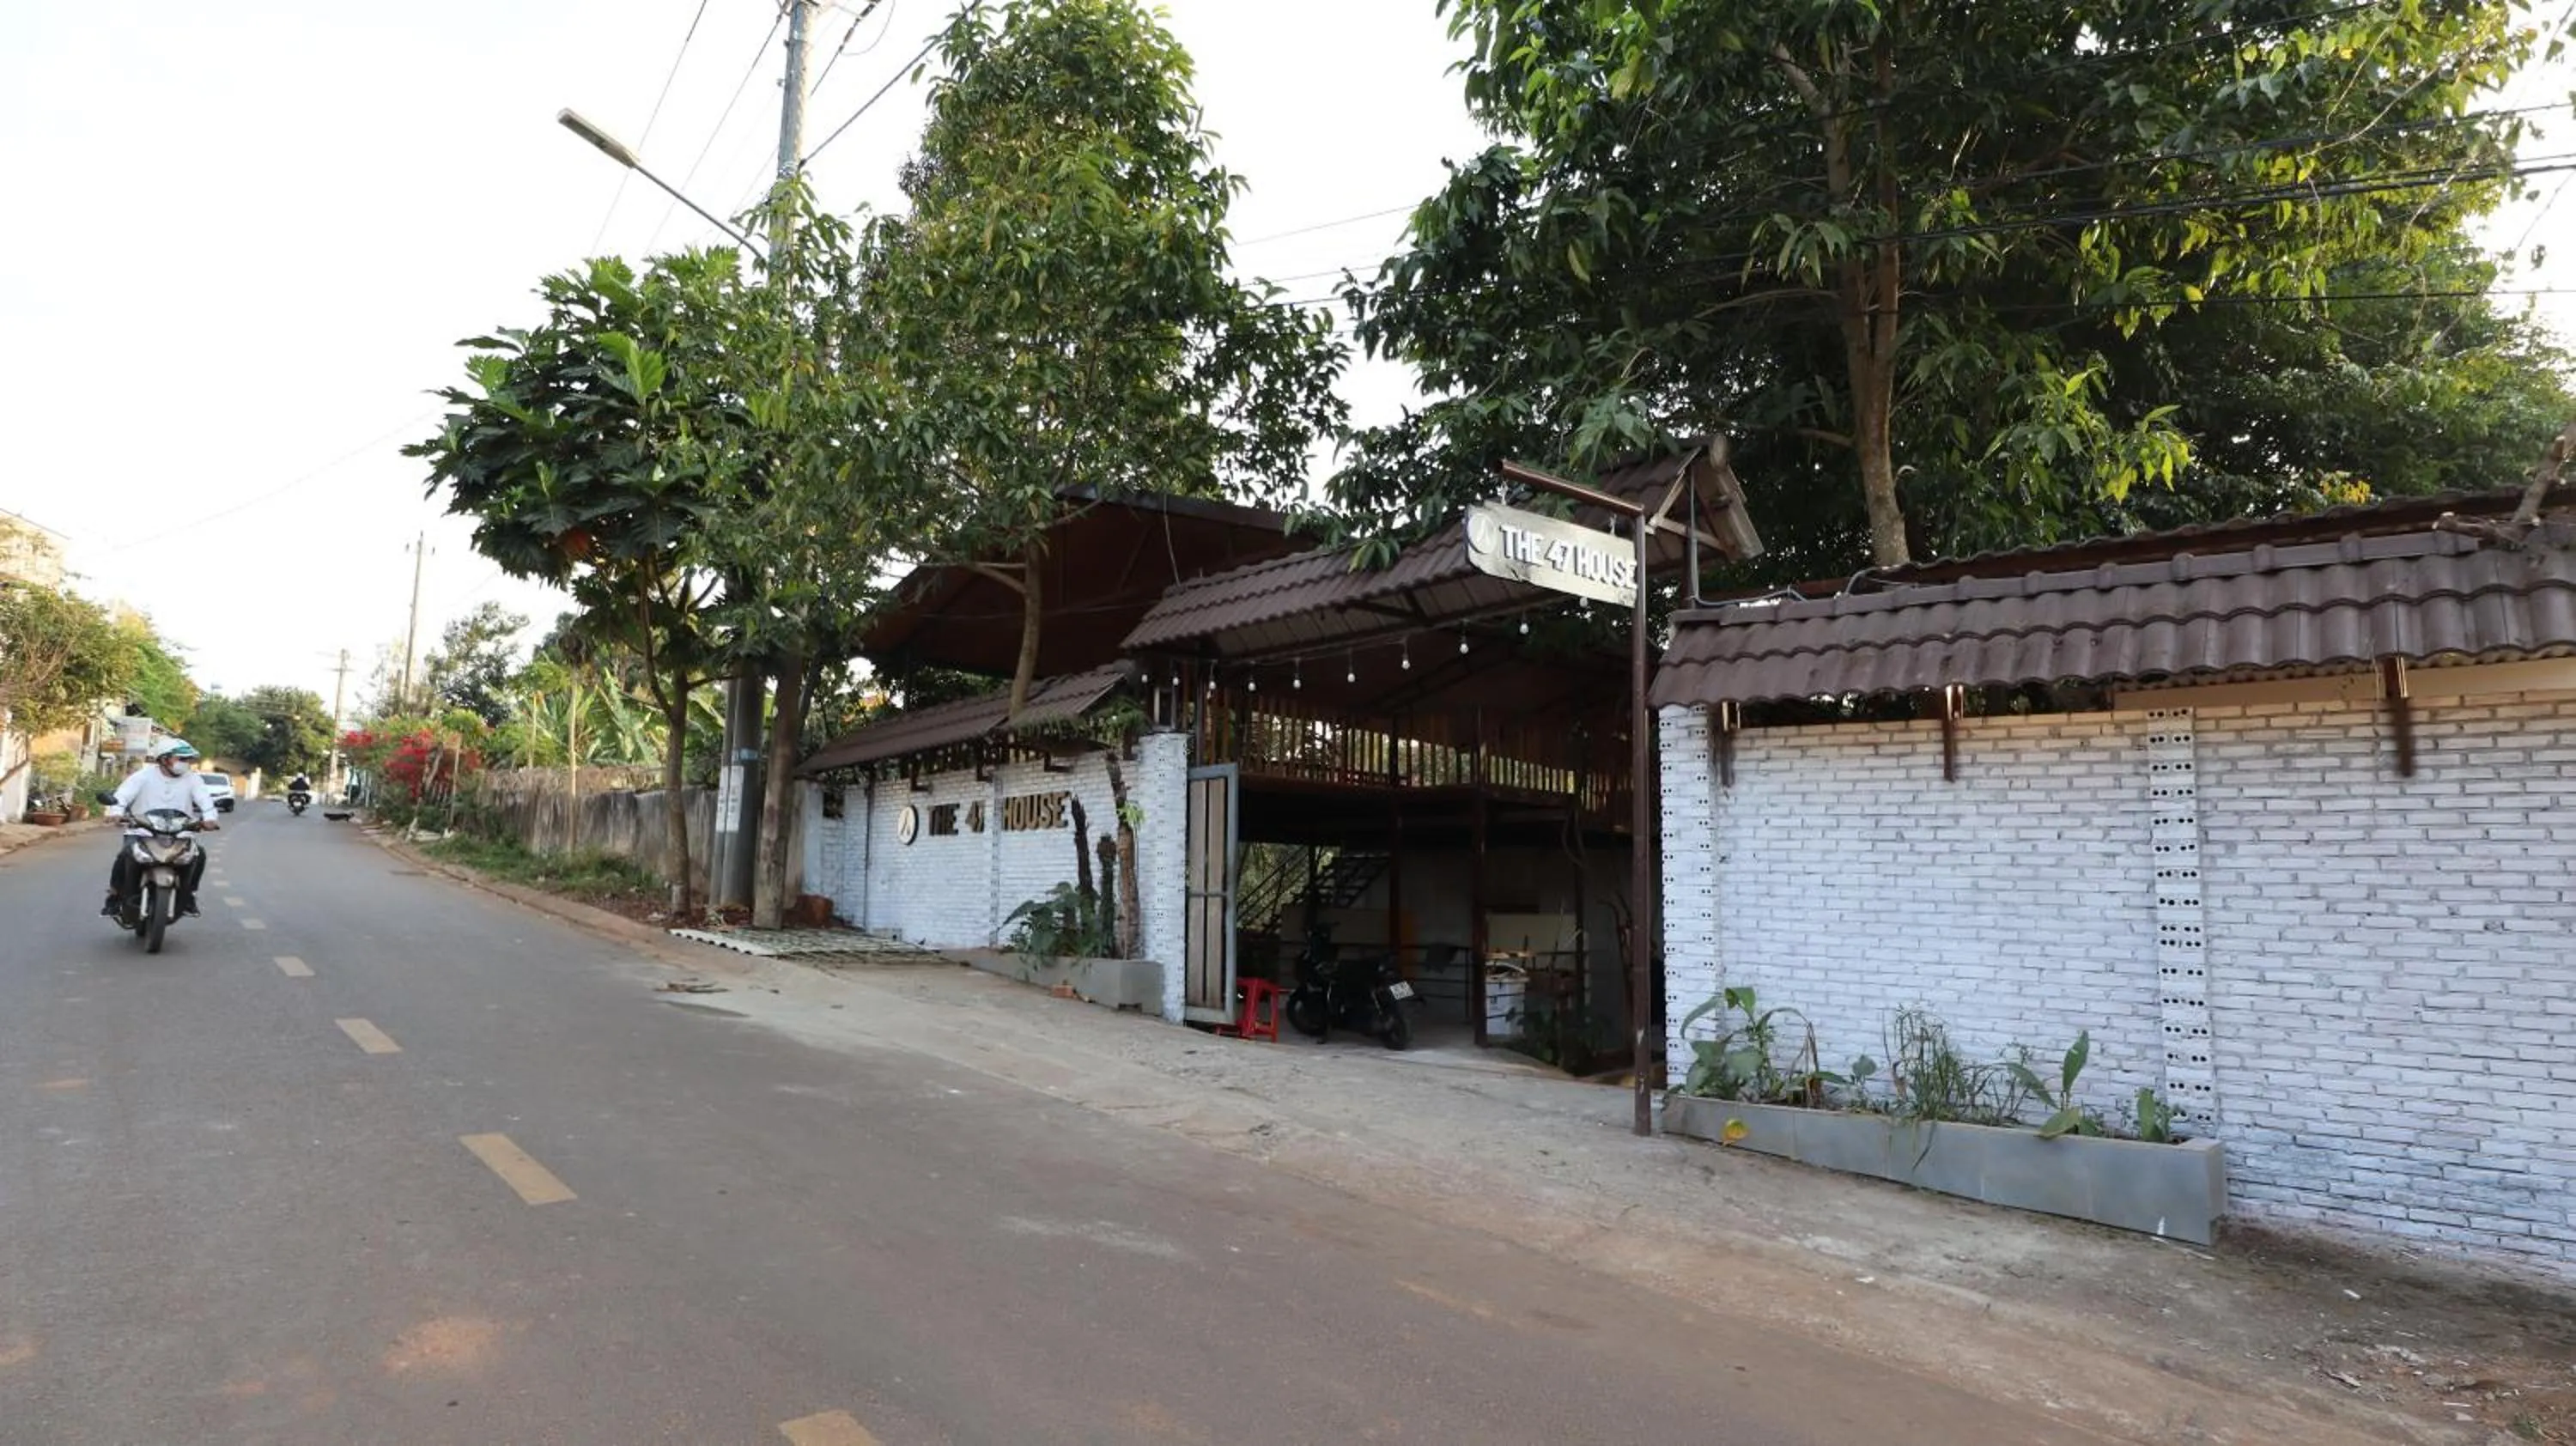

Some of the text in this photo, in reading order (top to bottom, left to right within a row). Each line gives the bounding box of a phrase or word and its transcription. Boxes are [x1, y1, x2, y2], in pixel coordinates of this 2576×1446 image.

[1500, 524, 1637, 589] THE 47 HOUSE
[927, 803, 960, 835] THE
[1003, 791, 1071, 831] HOUSE
